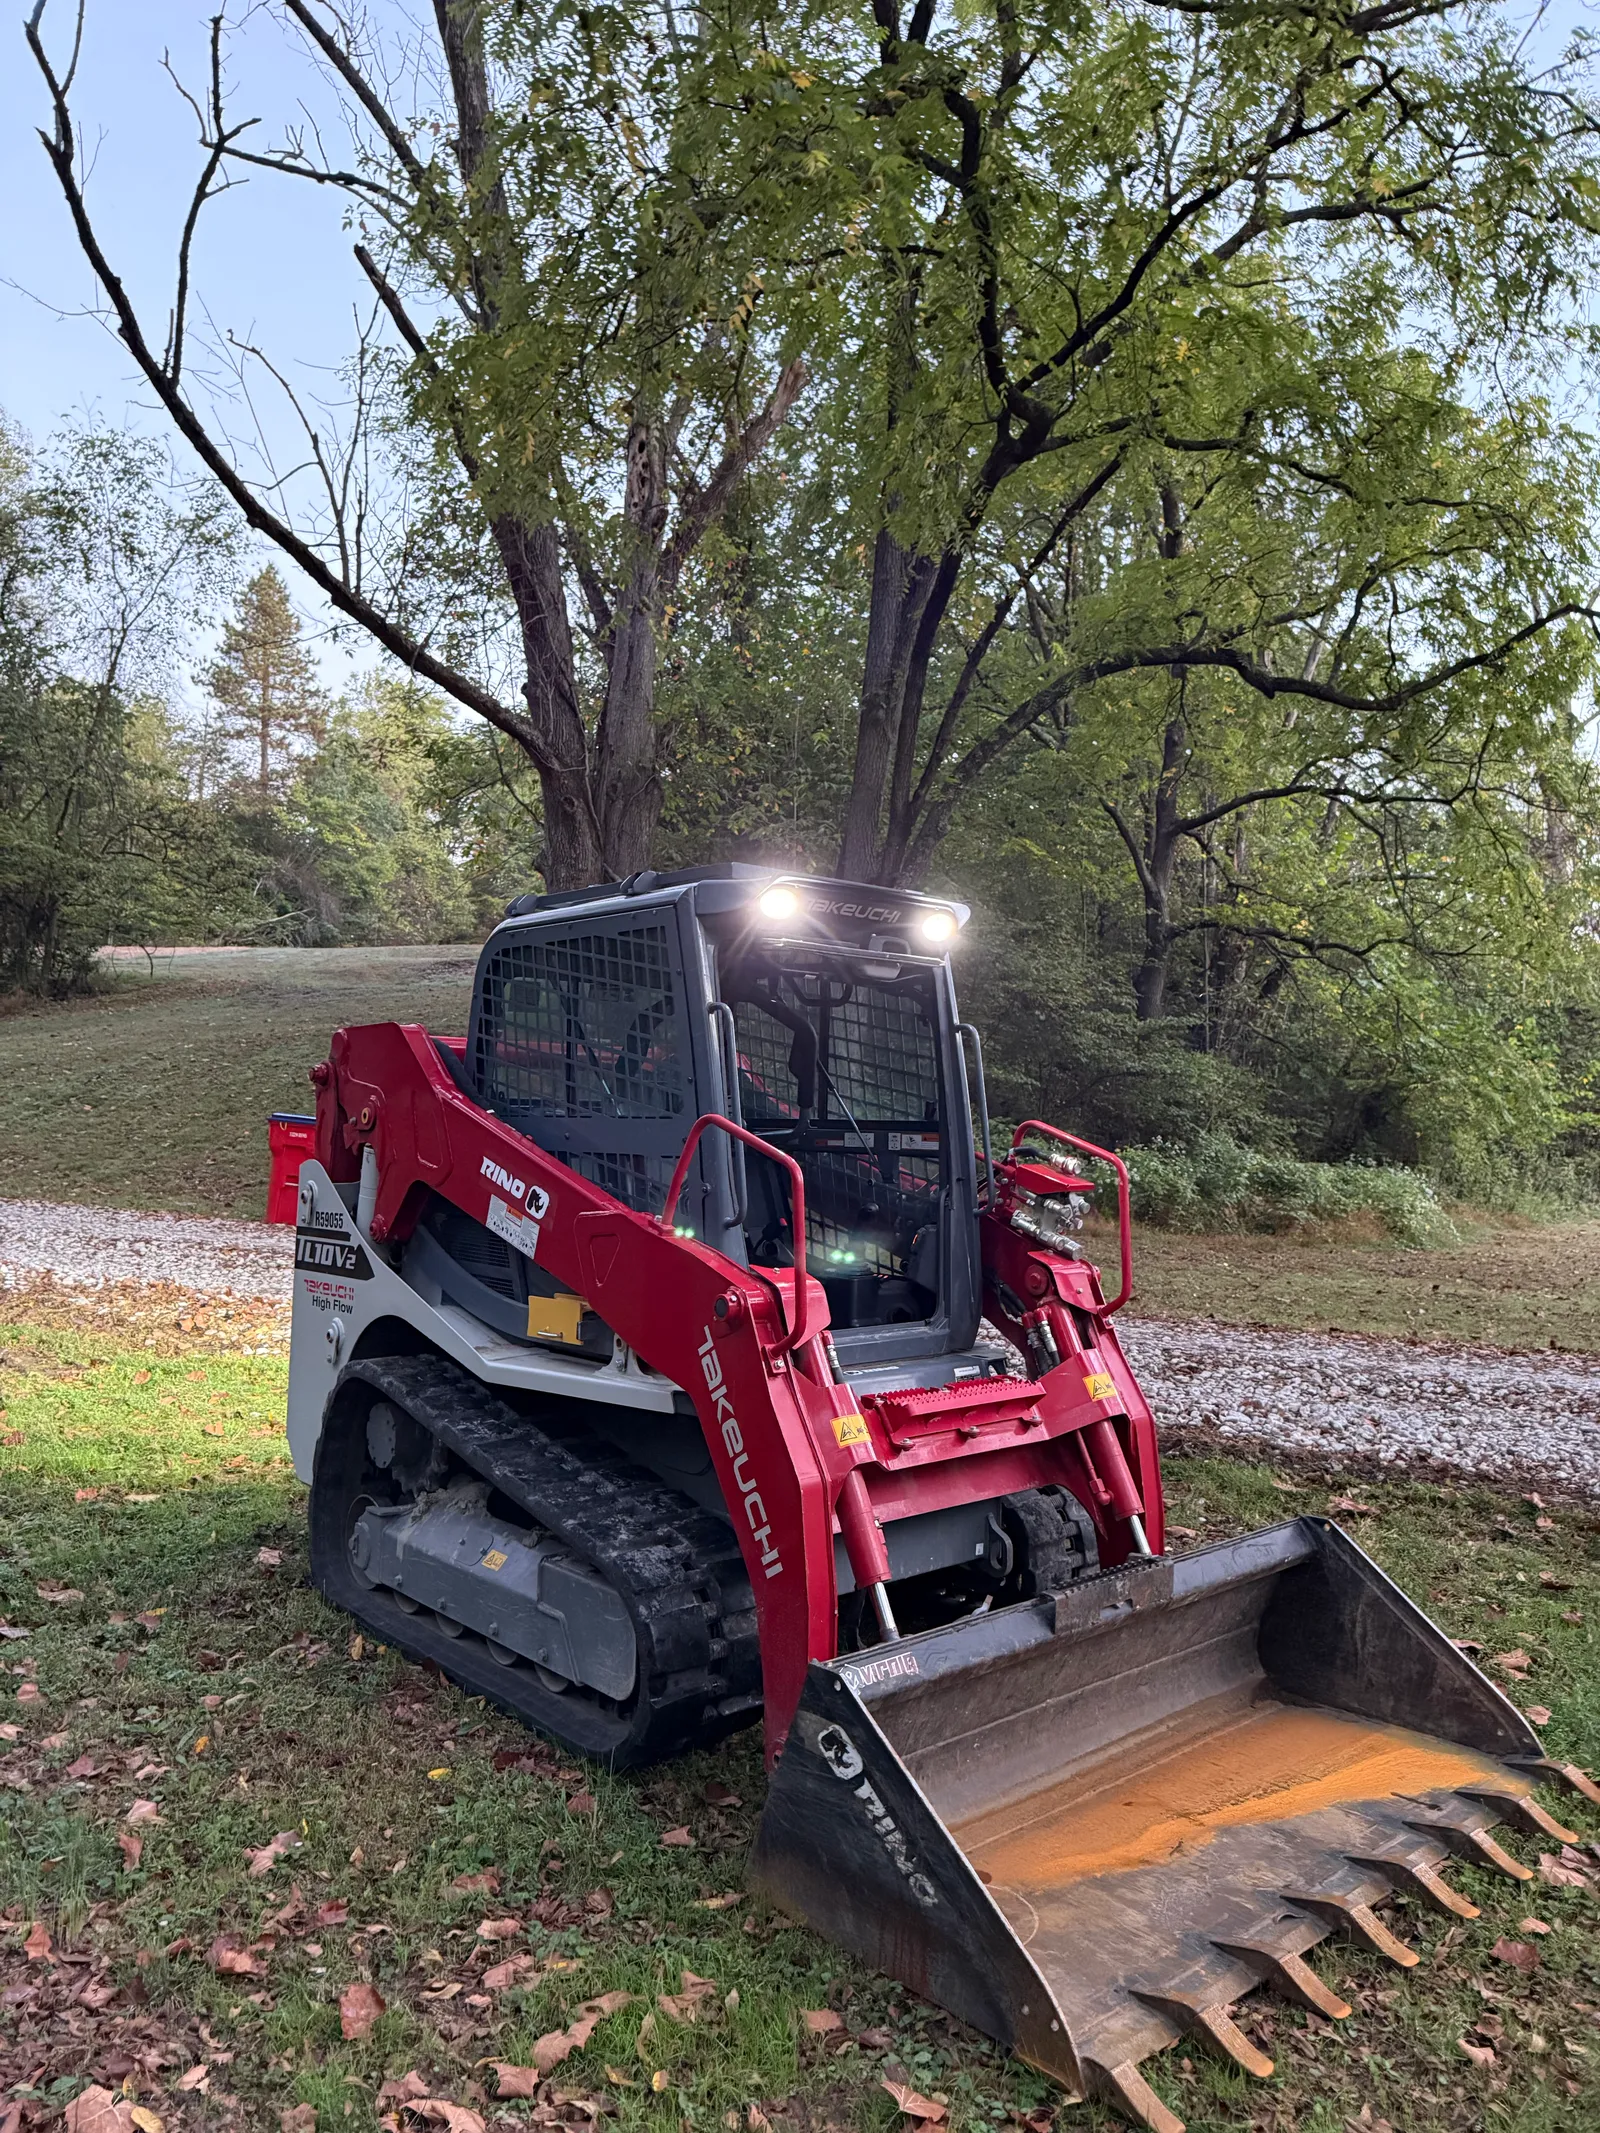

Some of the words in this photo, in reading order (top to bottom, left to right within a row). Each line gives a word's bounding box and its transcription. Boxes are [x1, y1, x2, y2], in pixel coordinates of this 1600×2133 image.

[480, 1155, 526, 1199] RINO
[315, 1211, 344, 1229] R59055
[295, 1235, 357, 1270] TL10V2
[312, 1295, 331, 1311] High
[333, 1299, 354, 1315] Flow
